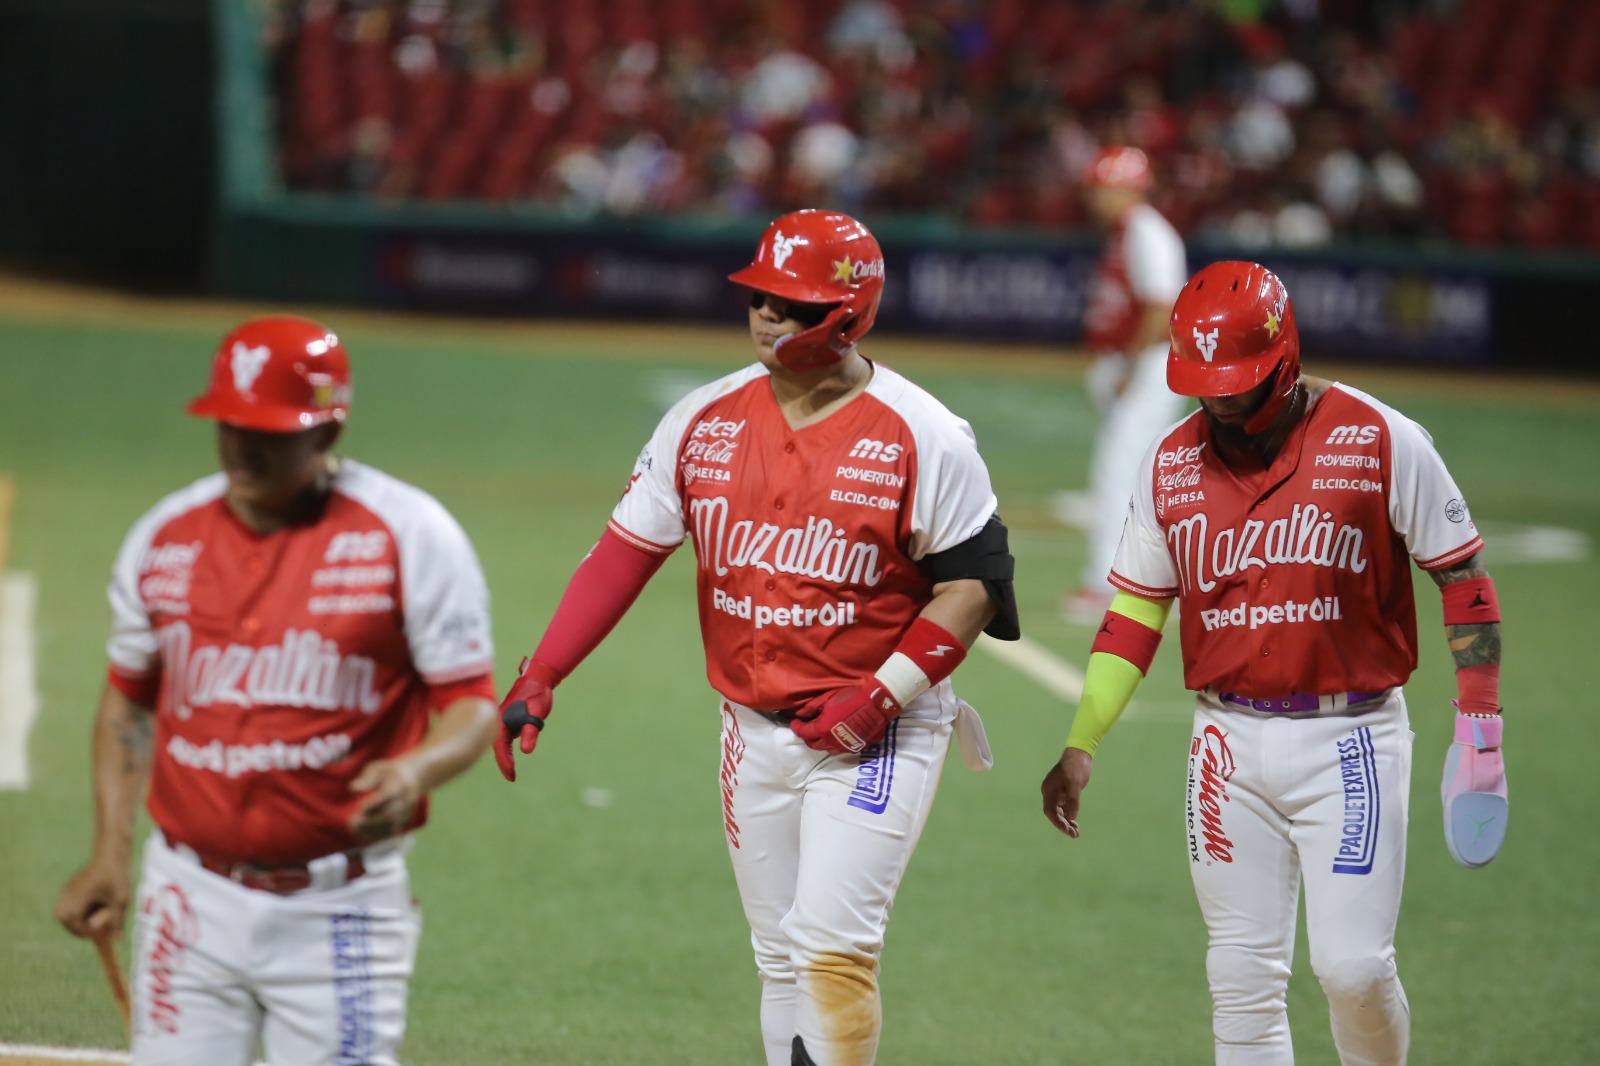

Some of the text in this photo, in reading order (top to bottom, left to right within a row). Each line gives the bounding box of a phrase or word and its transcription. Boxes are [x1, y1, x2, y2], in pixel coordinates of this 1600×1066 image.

[830, 489, 900, 511] ELCID.COM
[1168, 491, 1205, 507] HERSA
[1312, 478, 1383, 493] ELCID.COM
[690, 495, 882, 587] Mazatlán
[1168, 503, 1367, 597] Mazatlán
[713, 587, 855, 628] Red petroil
[1200, 596, 1341, 632] Red petroil
[1187, 757, 1200, 863] caliente.mx
[1199, 724, 1237, 863] Caliente
[1337, 737, 1366, 857] PAQUETEXPRESS
